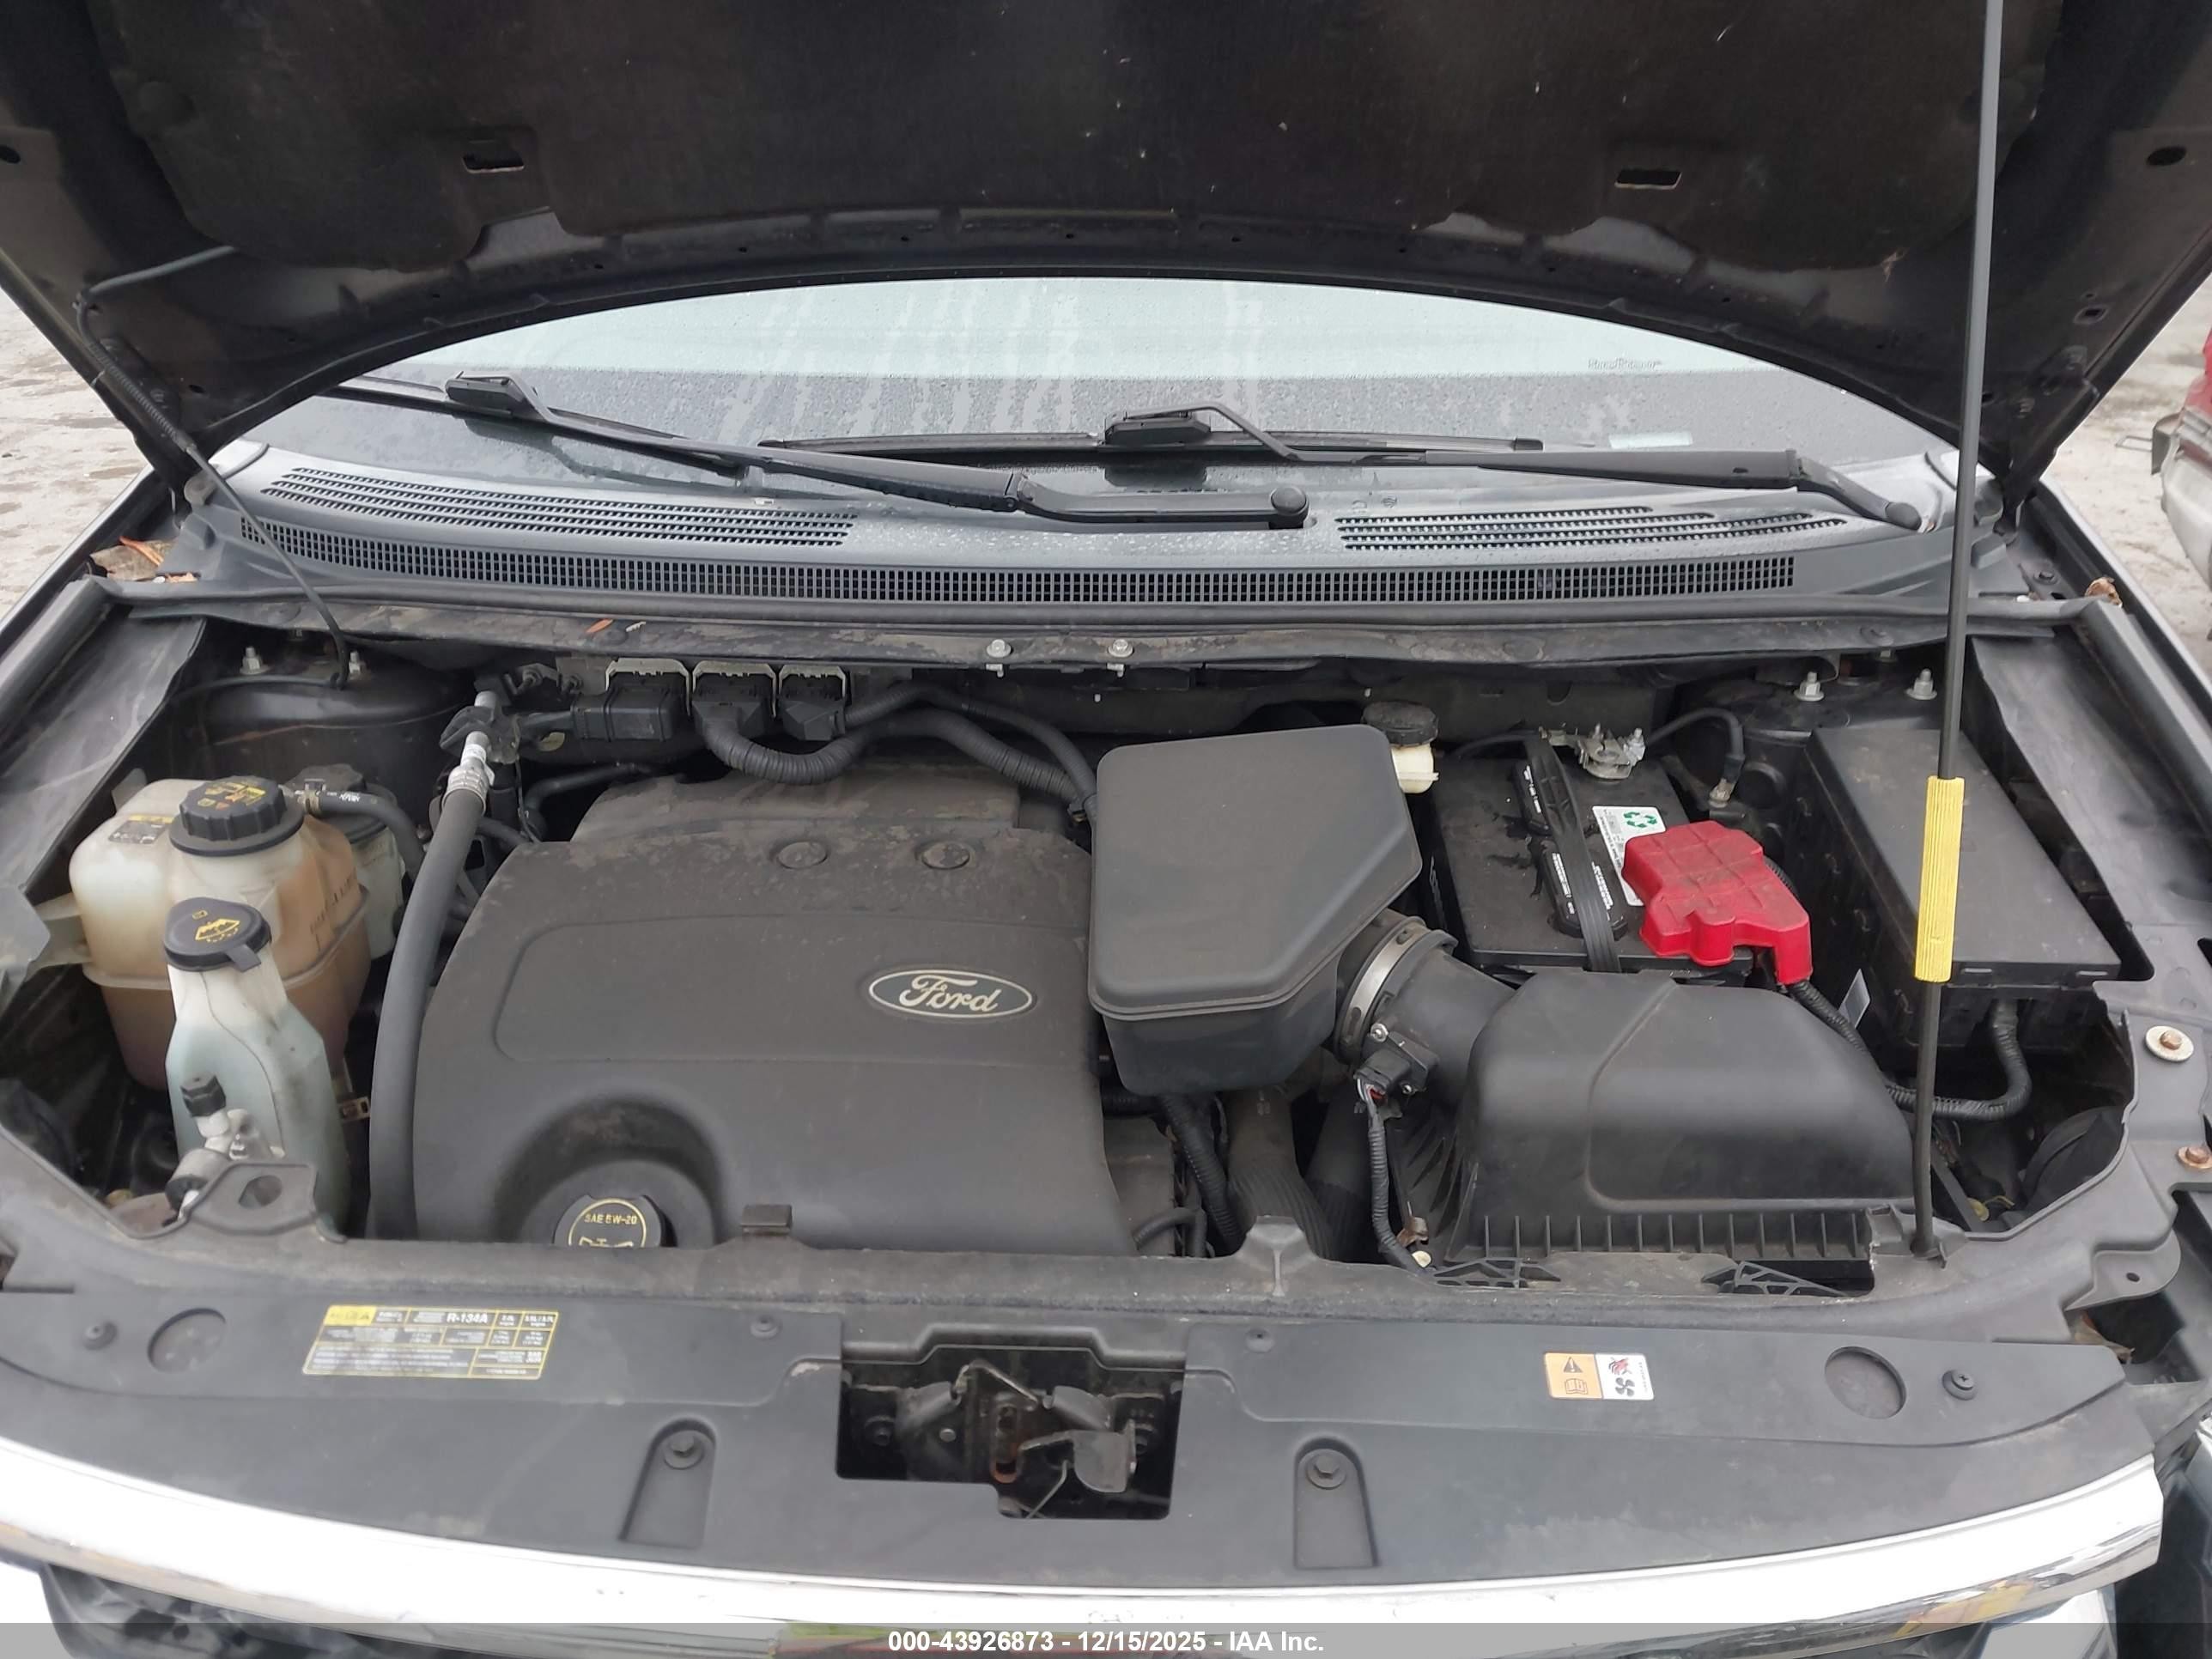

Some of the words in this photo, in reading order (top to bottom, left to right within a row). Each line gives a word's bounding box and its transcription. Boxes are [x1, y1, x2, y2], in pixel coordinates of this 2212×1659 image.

[899, 975, 1002, 1012] Ford
[584, 1213, 604, 1224] SAE
[447, 1312, 488, 1324] R-134A
